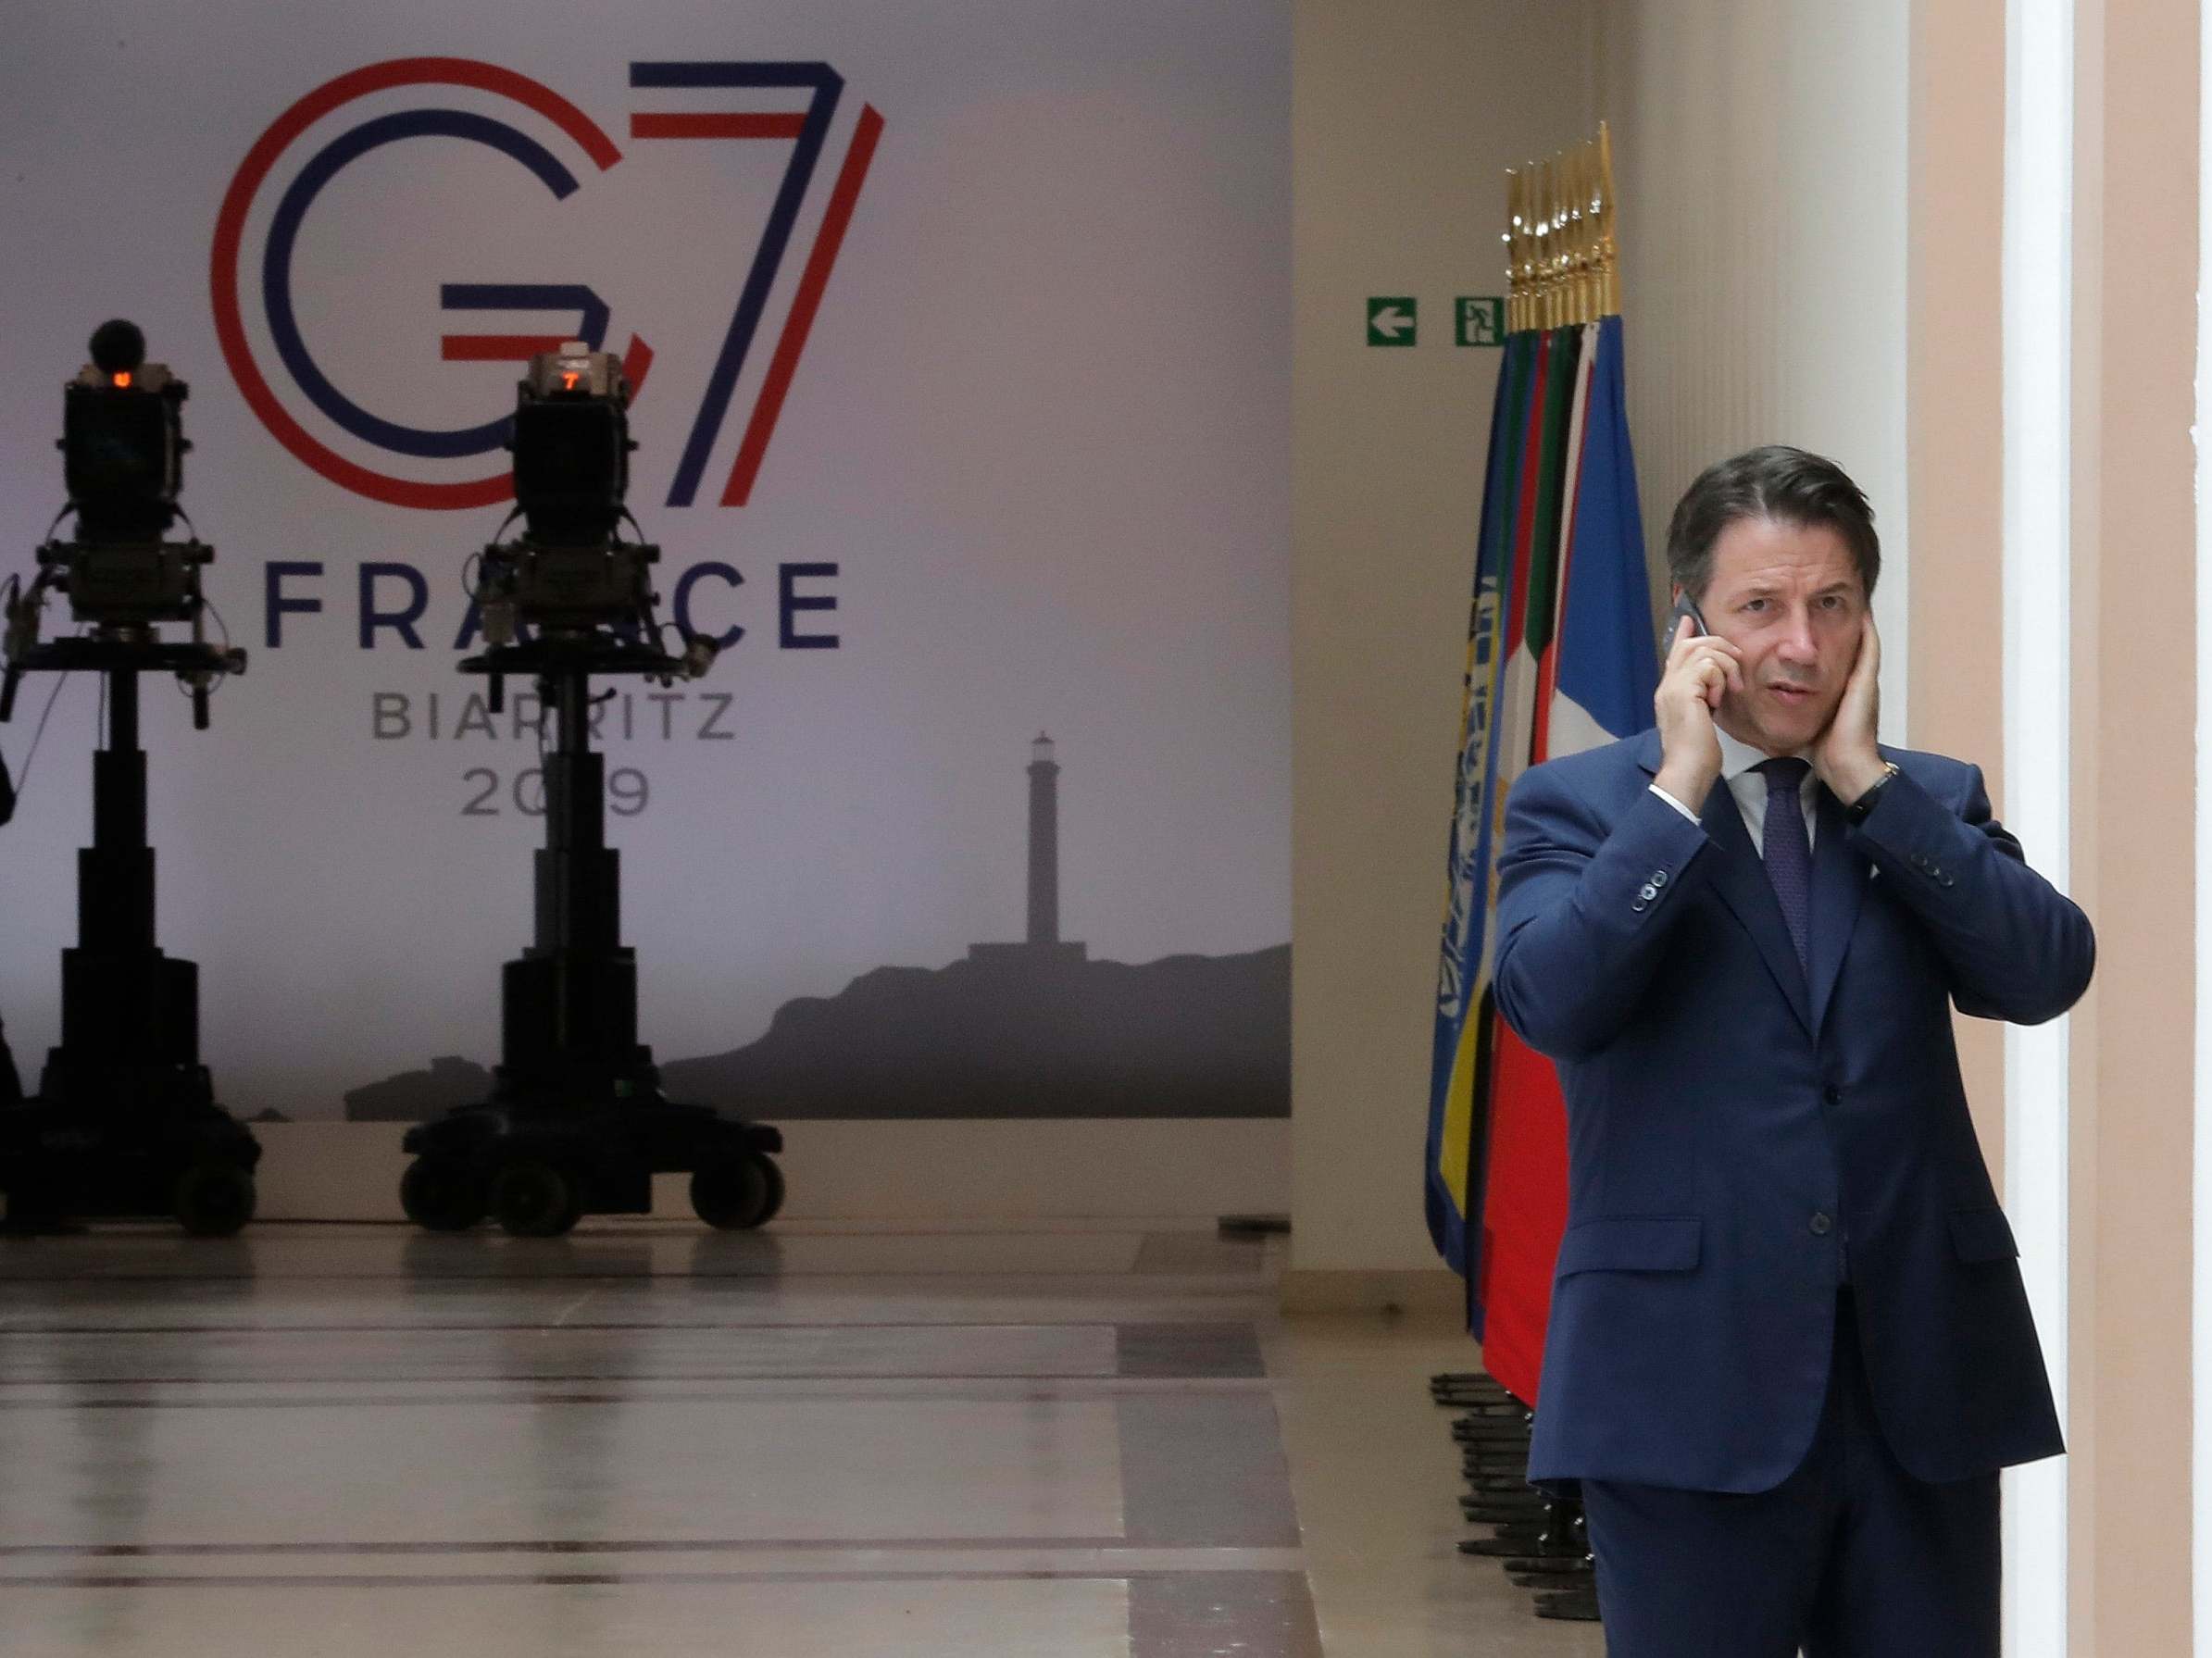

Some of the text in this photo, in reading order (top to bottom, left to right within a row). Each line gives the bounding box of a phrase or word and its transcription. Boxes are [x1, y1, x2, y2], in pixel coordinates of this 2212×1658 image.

[211, 56, 885, 510] G7
[266, 561, 840, 649] FRCE
[461, 767, 648, 816] 209
